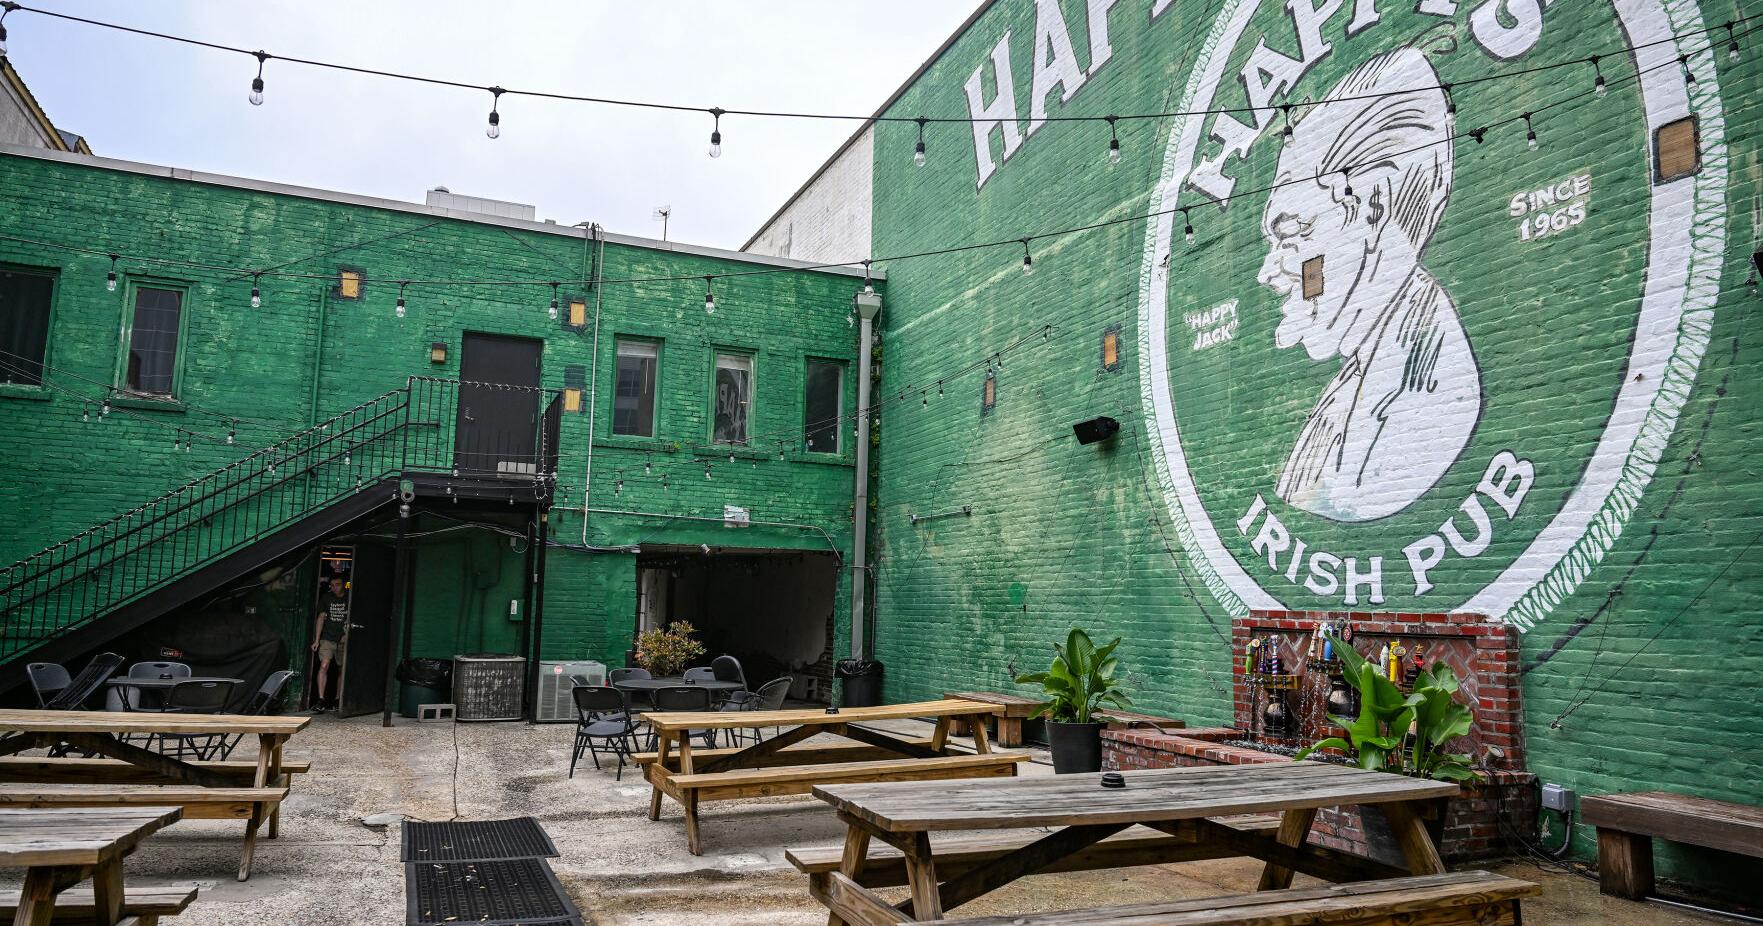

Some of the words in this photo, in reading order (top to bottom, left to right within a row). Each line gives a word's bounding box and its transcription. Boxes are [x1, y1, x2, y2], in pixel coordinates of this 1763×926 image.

[1510, 174, 1590, 217] SINCE
[1520, 200, 1586, 241] 1965
[1236, 493, 1385, 605] IRISH
[1401, 450, 1536, 597] PUB
